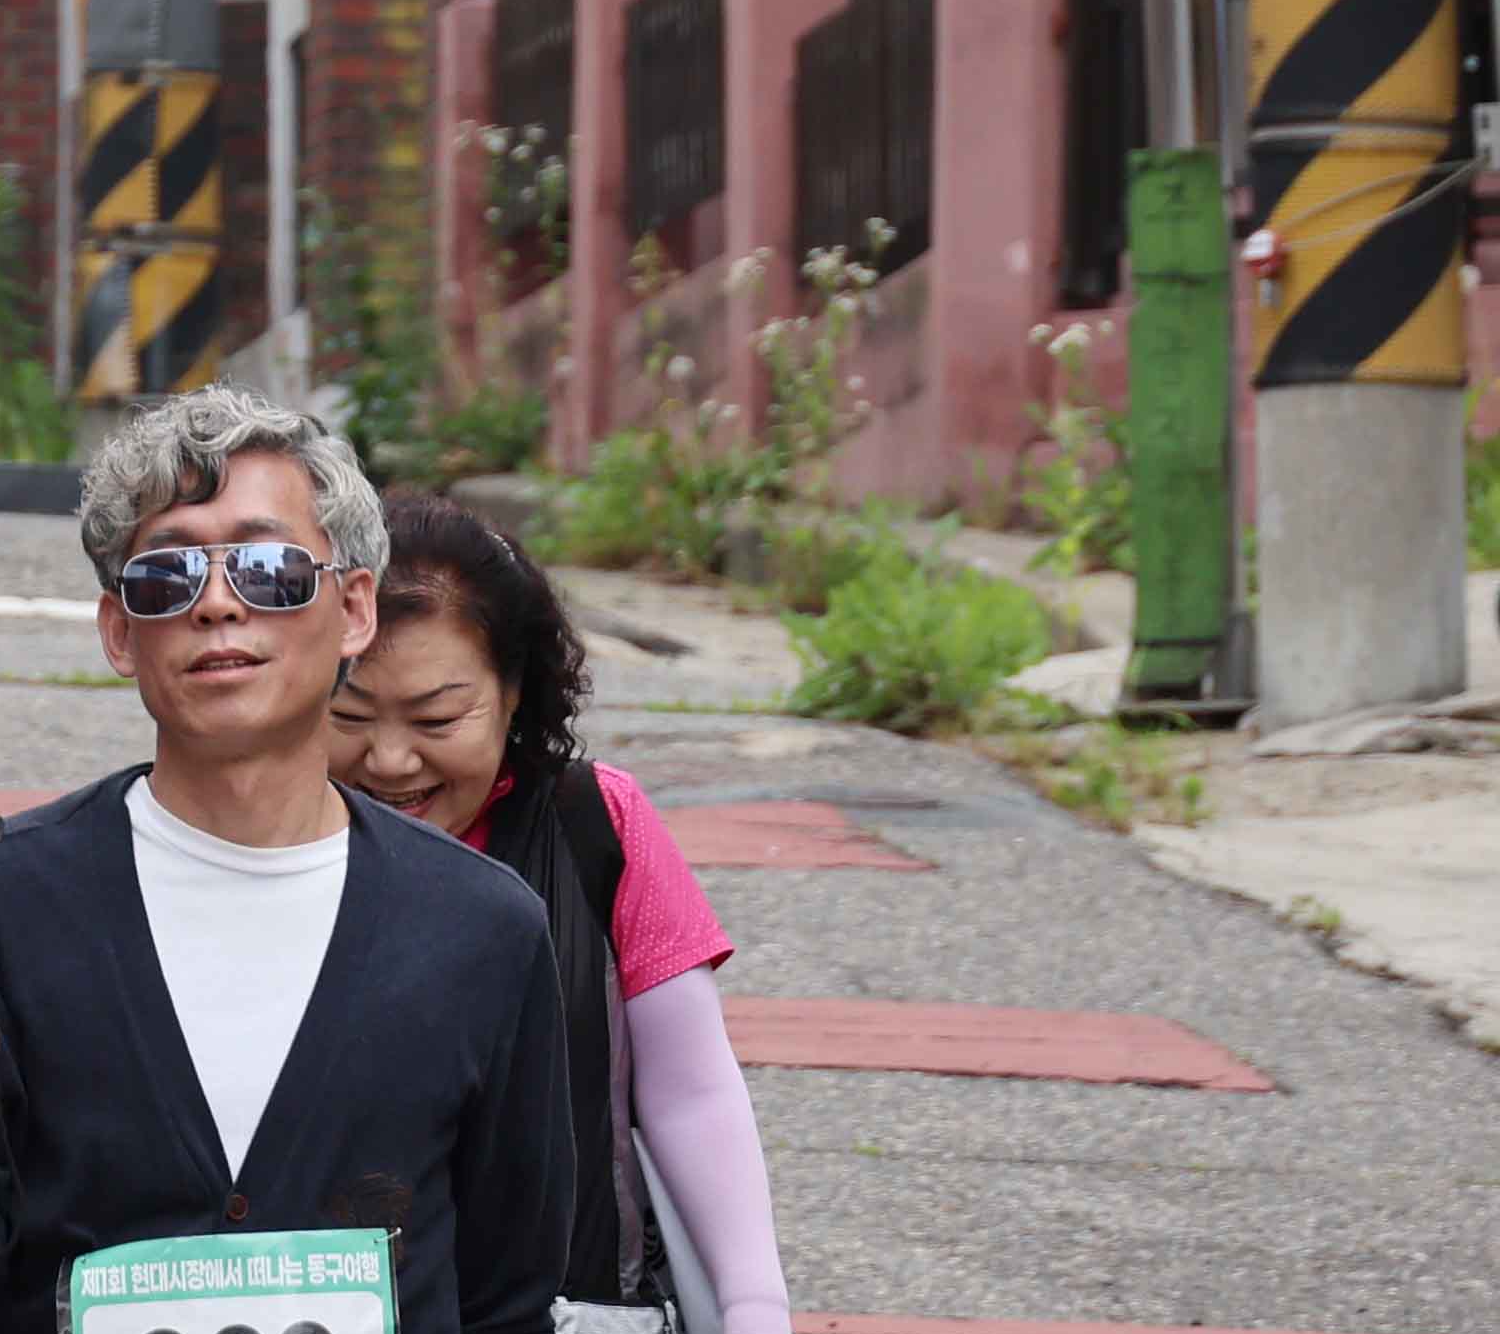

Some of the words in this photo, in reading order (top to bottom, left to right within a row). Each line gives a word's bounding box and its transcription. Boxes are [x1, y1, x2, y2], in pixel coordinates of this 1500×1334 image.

[81, 1266, 128, 1297] 제1회
[131, 1257, 246, 1294] 현대시장에서
[248, 1255, 304, 1287] 떠나는
[307, 1250, 381, 1286] 동구여행
